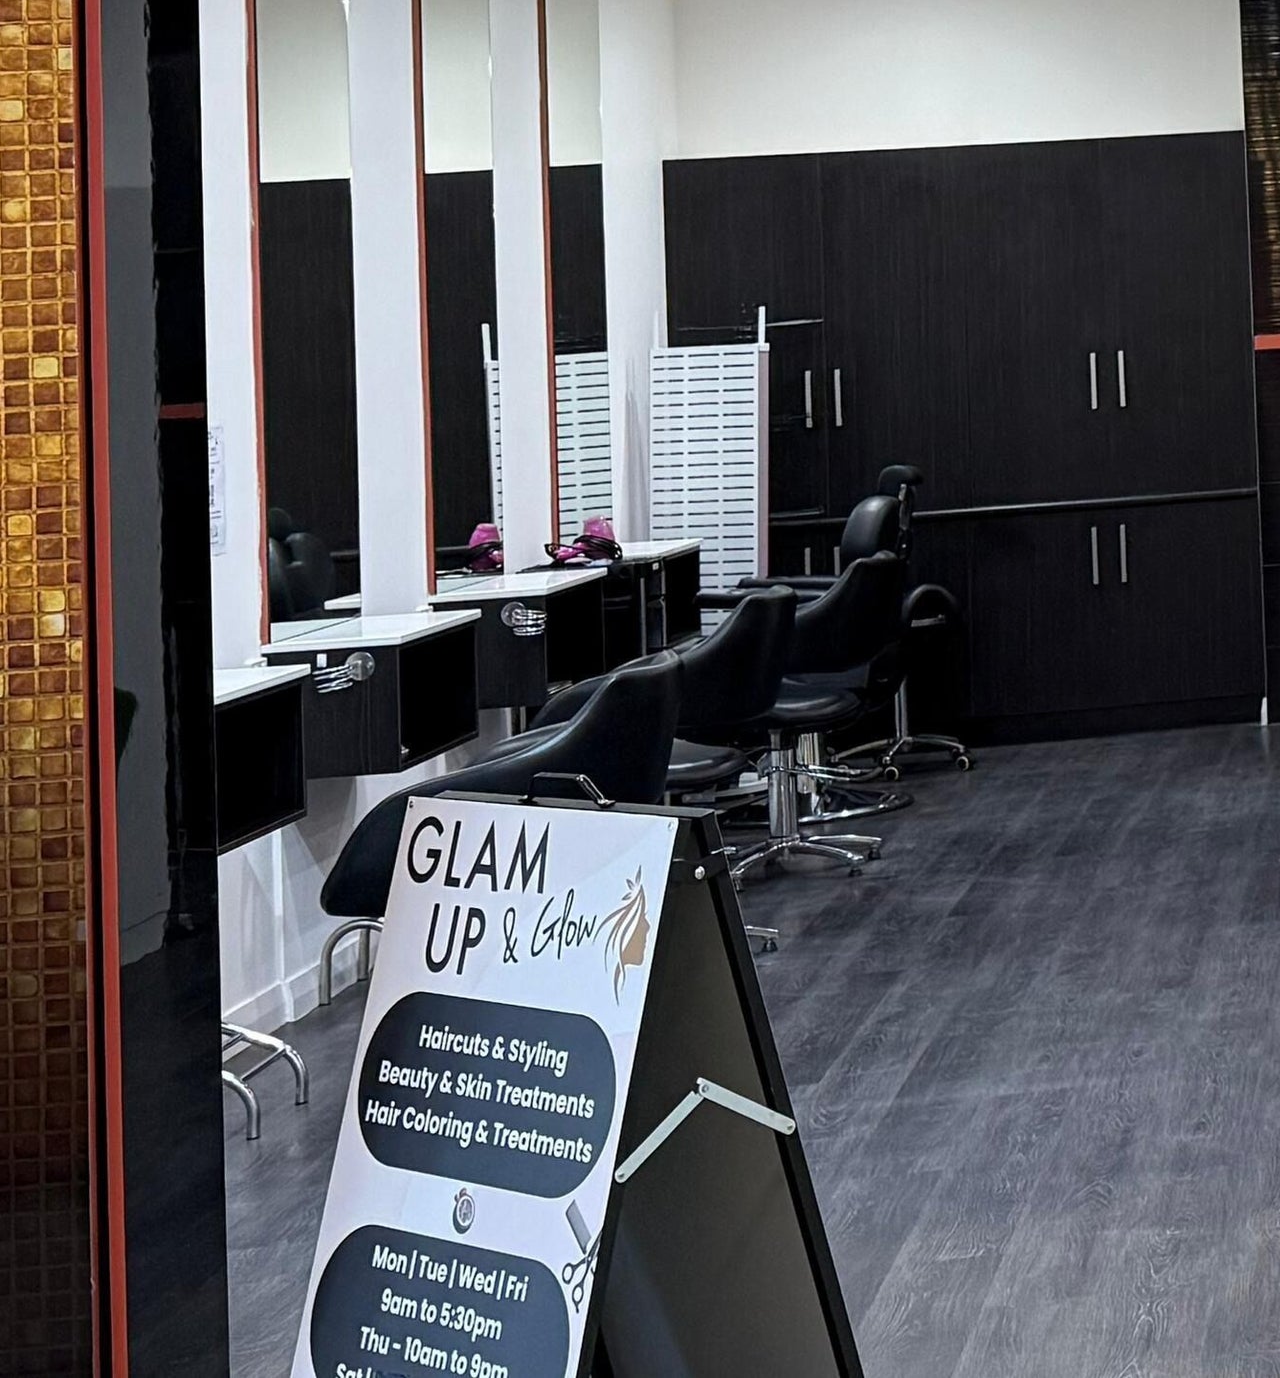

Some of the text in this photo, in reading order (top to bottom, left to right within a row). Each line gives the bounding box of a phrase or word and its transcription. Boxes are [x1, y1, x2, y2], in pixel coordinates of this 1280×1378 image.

[407, 815, 550, 894] GLAM
[425, 888, 598, 975] UP & Glow
[418, 1024, 568, 1077] Haircuts & Styling
[378, 1060, 595, 1119] Beauty & Skin Treatments
[365, 1099, 593, 1164] Hair Coloring & Treatments
[372, 1244, 407, 1275] Mon
[419, 1255, 448, 1283] Tue
[459, 1263, 497, 1295] Wed
[505, 1275, 529, 1302] Fri
[380, 1288, 502, 1342] 9am to 5:30pm
[360, 1325, 390, 1355] Thu
[404, 1336, 448, 1370] 10am
[450, 1349, 467, 1375] to
[470, 1353, 508, 1378] 9pm
